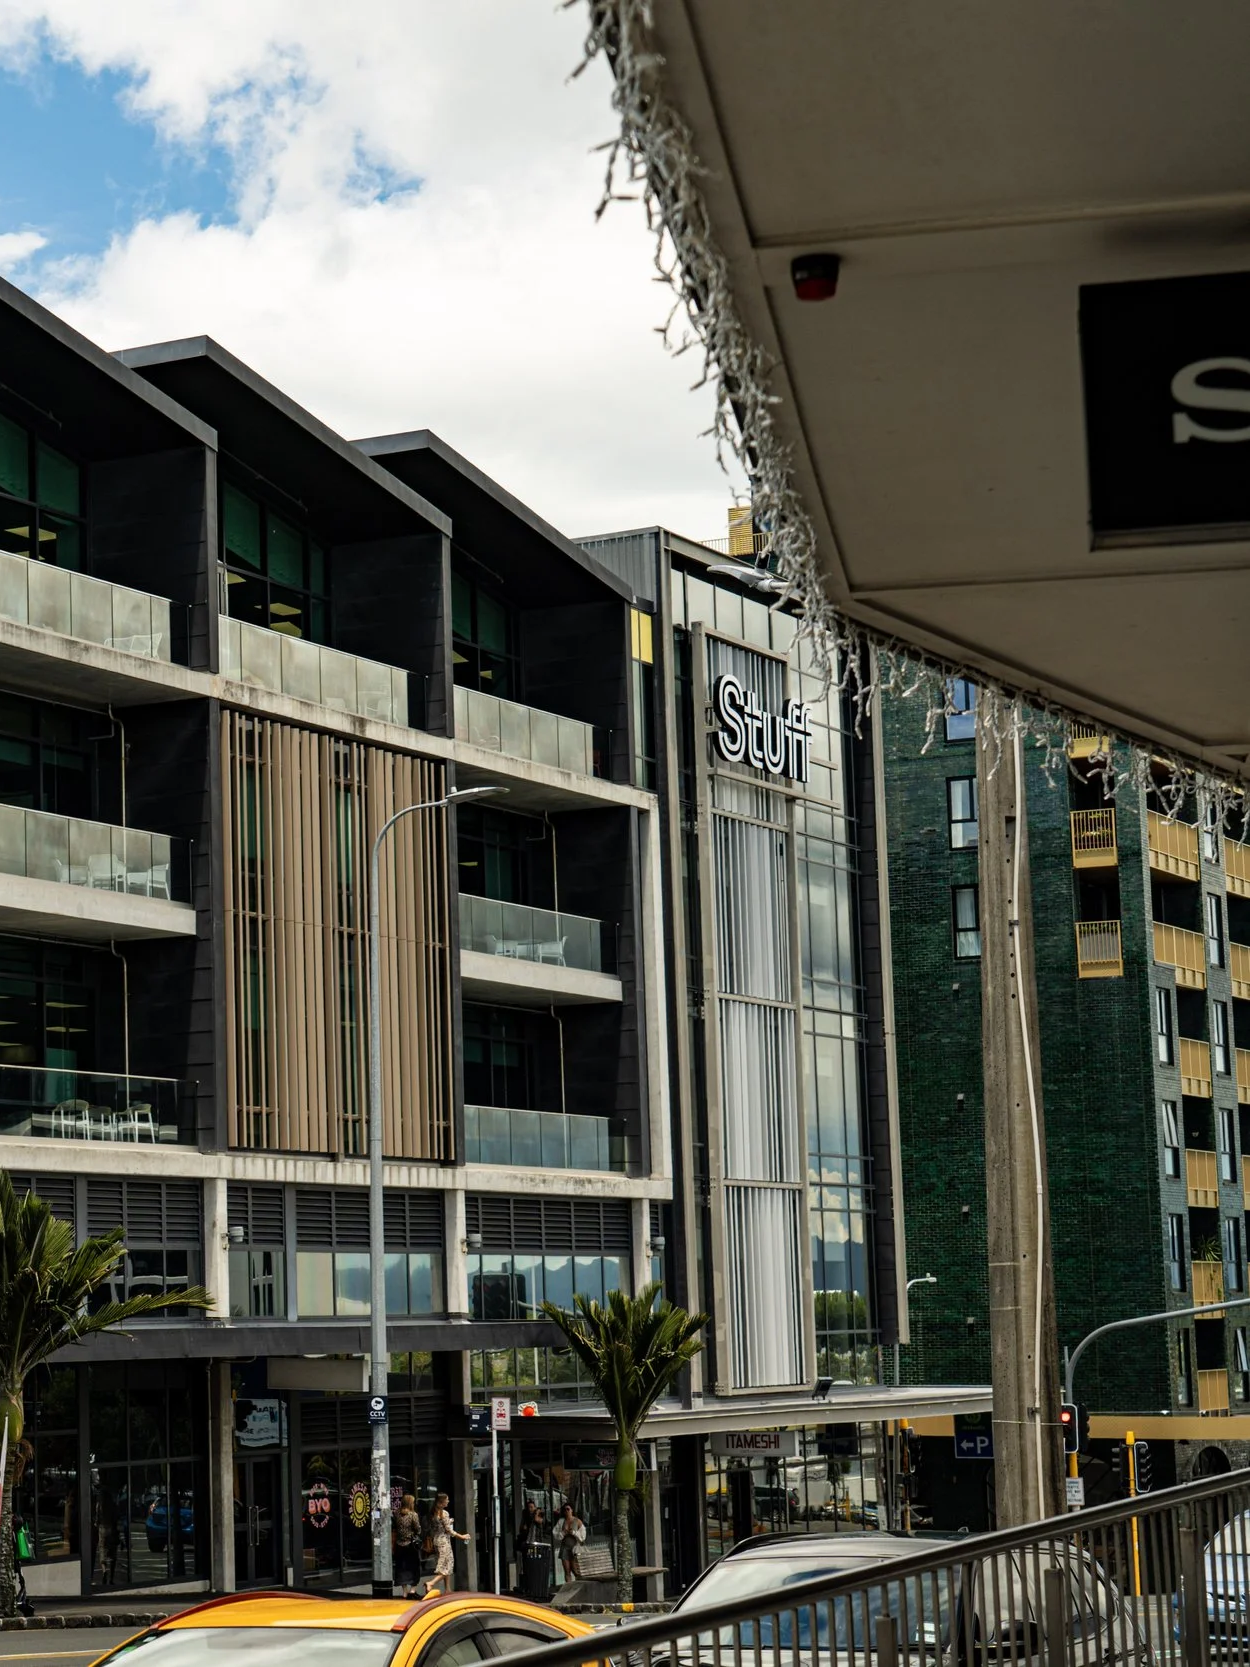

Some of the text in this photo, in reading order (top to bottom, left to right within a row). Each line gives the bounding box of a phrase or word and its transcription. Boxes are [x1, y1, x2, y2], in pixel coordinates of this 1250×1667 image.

[714, 674, 814, 783] Stuff
[725, 1433, 781, 1449] ITAMESHI
[976, 1435, 990, 1454] P
[308, 1497, 331, 1515] BYO
